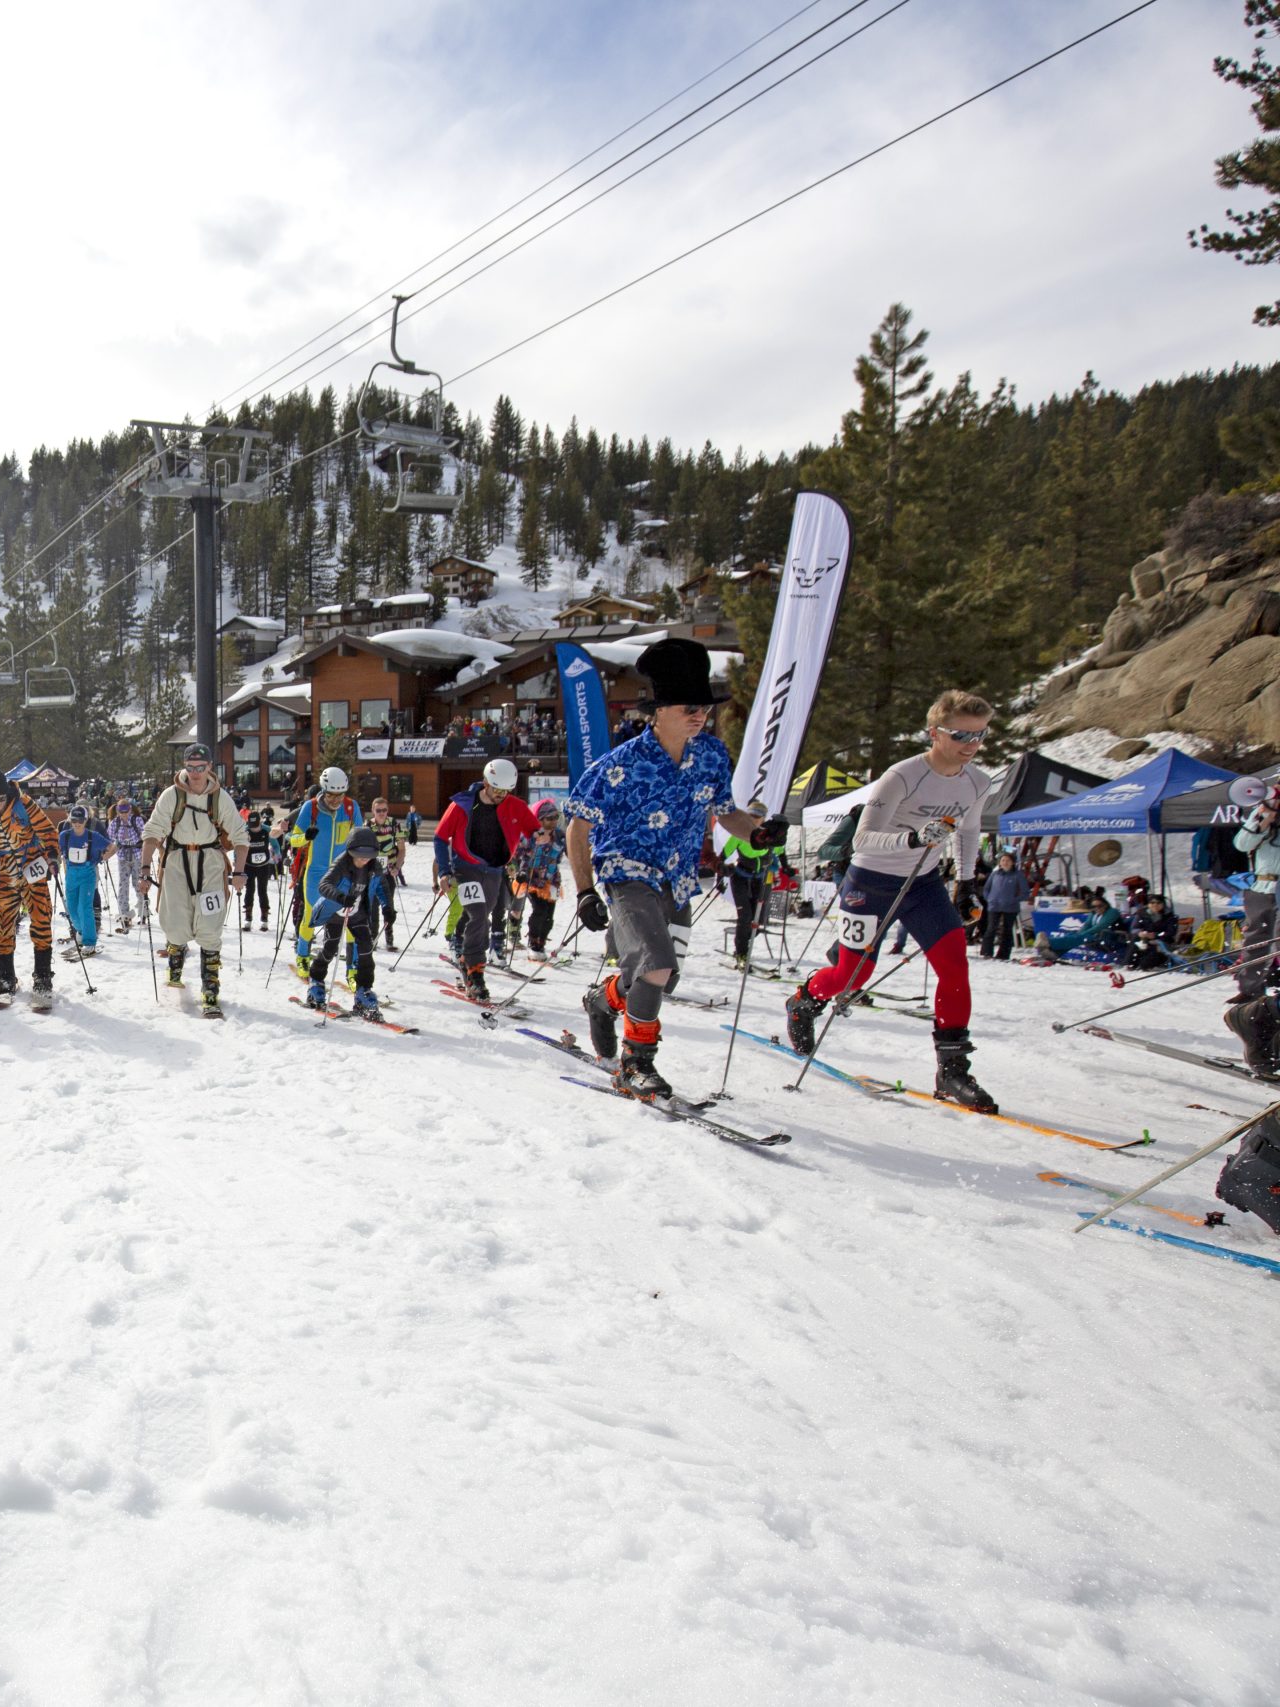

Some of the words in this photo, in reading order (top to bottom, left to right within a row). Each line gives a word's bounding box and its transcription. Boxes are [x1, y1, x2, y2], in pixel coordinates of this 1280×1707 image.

[575, 681, 590, 734] SPORTS
[1008, 818, 1135, 832] TahoeMountainSports.com
[29, 861, 45, 878] 45
[463, 884, 481, 899] 42
[205, 894, 220, 911] 61
[842, 916, 865, 943] 23
